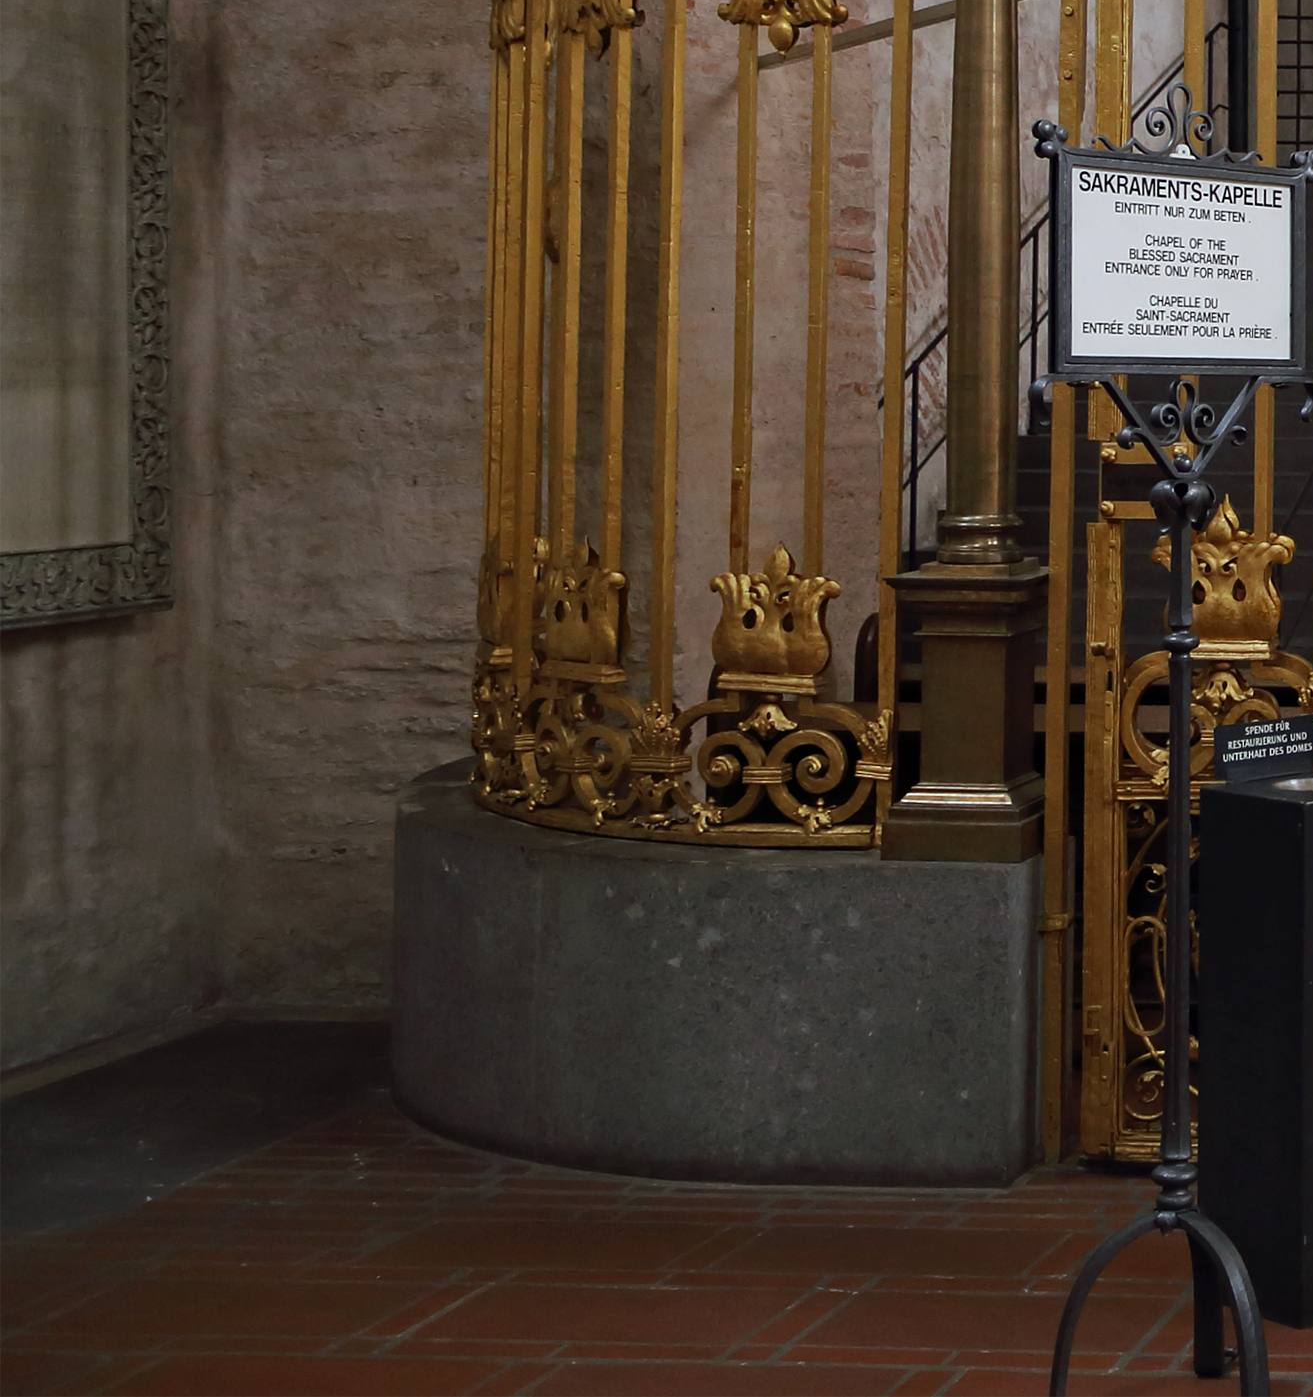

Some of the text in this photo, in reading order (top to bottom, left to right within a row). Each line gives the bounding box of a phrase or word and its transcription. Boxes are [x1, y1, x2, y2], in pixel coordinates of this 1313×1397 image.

[1079, 171, 1283, 208] SAKRAMENTS-KAPELLE
[1114, 201, 1160, 216] EINTRITT
[1164, 205, 1185, 218] NUR
[1188, 207, 1211, 221] ZUM
[1144, 234, 1226, 251] CHAPEL OF THE
[1129, 249, 1240, 266] BLESSED SACRAMENT
[1105, 262, 1161, 276] ENTRANCE
[1165, 265, 1190, 278] ONLY
[1193, 266, 1214, 279] FOR
[1149, 295, 1219, 309] CHAPELLE DU
[1135, 309, 1231, 324] SAINT-SACRAMENT
[1082, 320, 1124, 335] ENTRÉE
[1127, 325, 1191, 337] SEULEMENT
[1192, 326, 1220, 337] POUR
[1222, 327, 1236, 338] LA
[1245, 724, 1274, 735] SPENDE
[1228, 731, 1308, 749] RESTAURIERUNG UND
[1222, 743, 1313, 762] UNTERHALT DES DOMES
